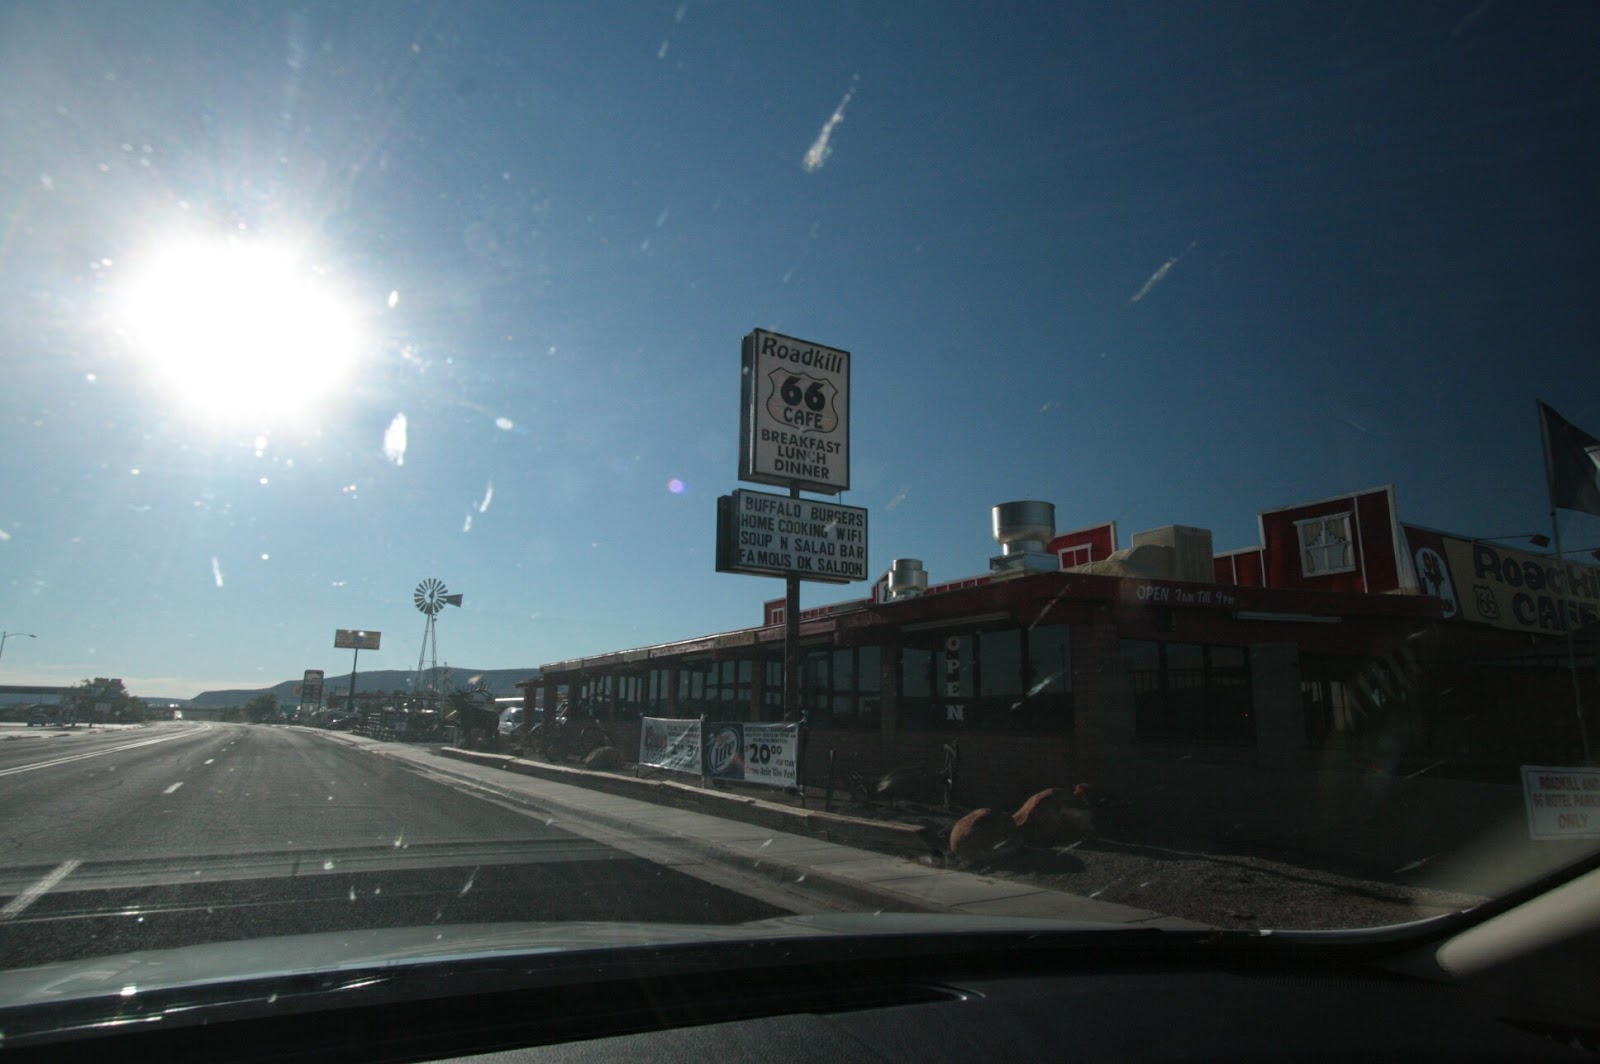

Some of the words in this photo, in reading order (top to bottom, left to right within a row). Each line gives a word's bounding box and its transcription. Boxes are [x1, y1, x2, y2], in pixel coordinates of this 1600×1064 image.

[761, 336, 843, 374] Roadkill
[780, 375, 826, 412] 66
[783, 406, 823, 429] CAFE
[761, 428, 841, 454] BREAKFAST
[777, 445, 826, 465] LUNCH
[774, 459, 829, 479] DINNER
[745, 496, 801, 518] BUFFALO
[811, 507, 863, 527] BURGERS
[741, 514, 774, 531] HOME
[778, 519, 828, 538] COOKING
[836, 527, 862, 543] WIFI
[741, 531, 772, 548] SOUP
[780, 536, 789, 550] N
[795, 538, 835, 556] SALAD
[840, 545, 864, 559] BAR
[739, 548, 791, 568] FAMOUS
[797, 555, 812, 571] OK
[818, 558, 862, 576] SALOON
[1136, 585, 1169, 601] OPEN
[1512, 592, 1598, 631] CAFE
[945, 635, 965, 721] OPEN
